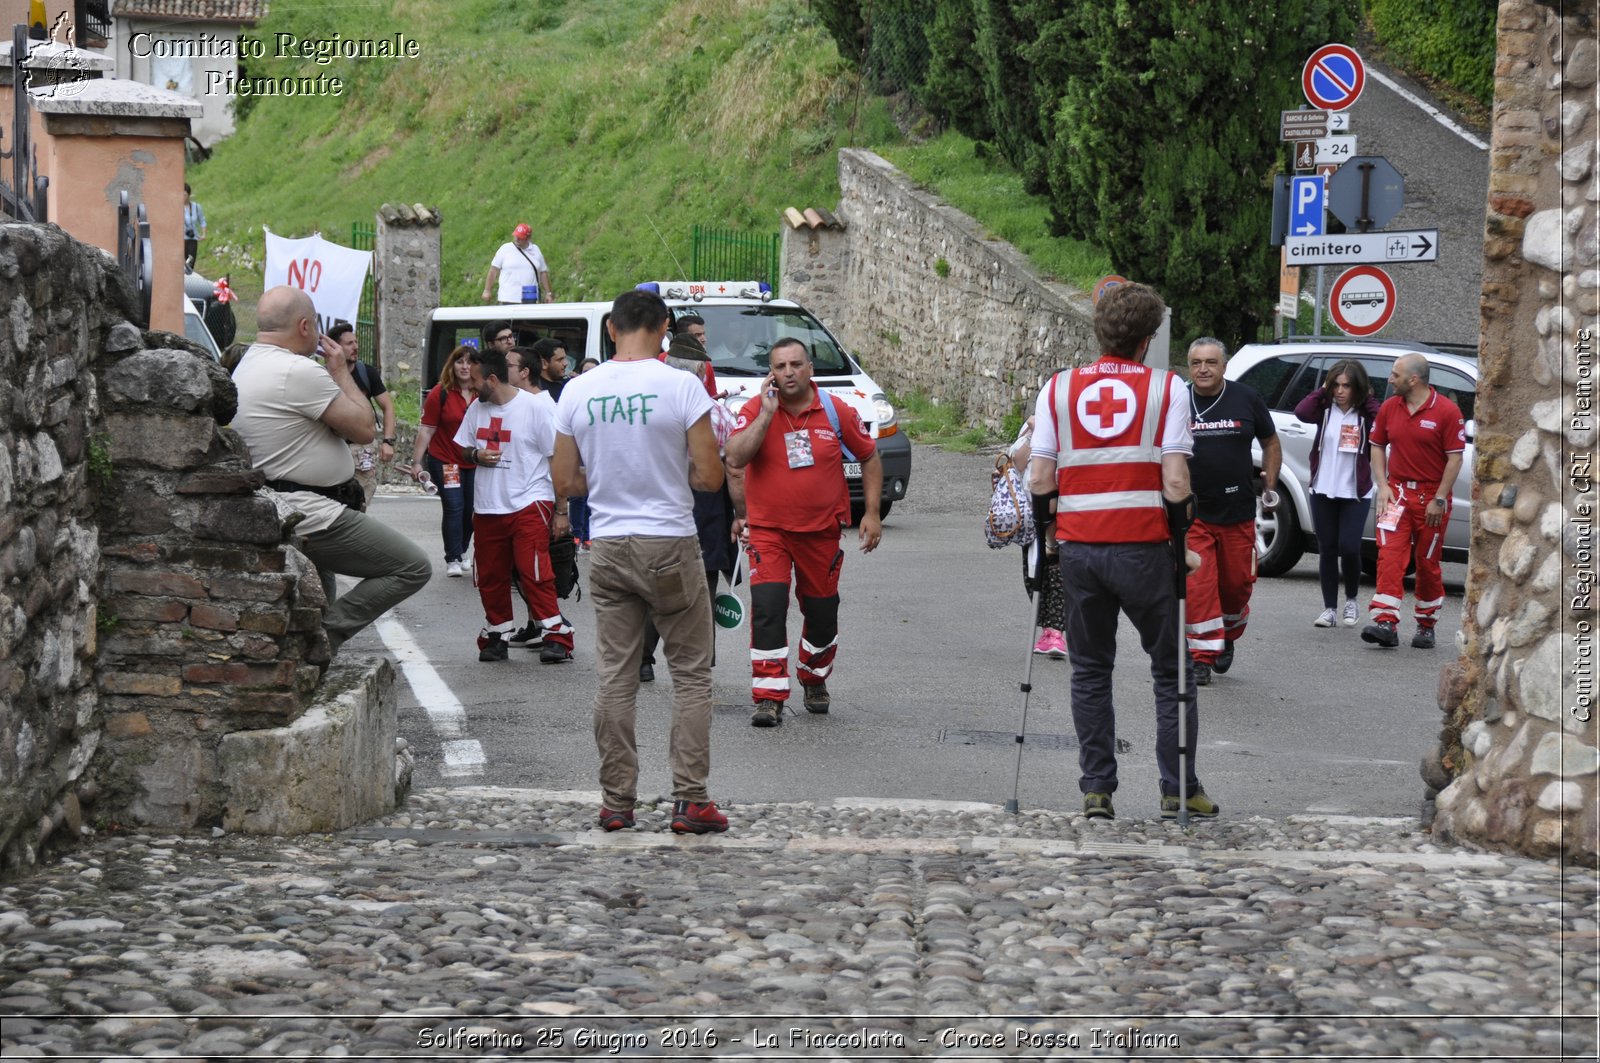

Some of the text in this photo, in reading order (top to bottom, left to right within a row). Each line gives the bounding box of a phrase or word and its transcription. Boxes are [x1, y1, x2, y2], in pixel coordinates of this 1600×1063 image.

[1331, 143, 1349, 155] 24
[1298, 181, 1317, 215] P
[1291, 242, 1362, 257] cimitero
[287, 258, 322, 293] NO
[1078, 361, 1145, 376] CROCE ROSSA ITALIANA
[586, 392, 658, 427] STAFF
